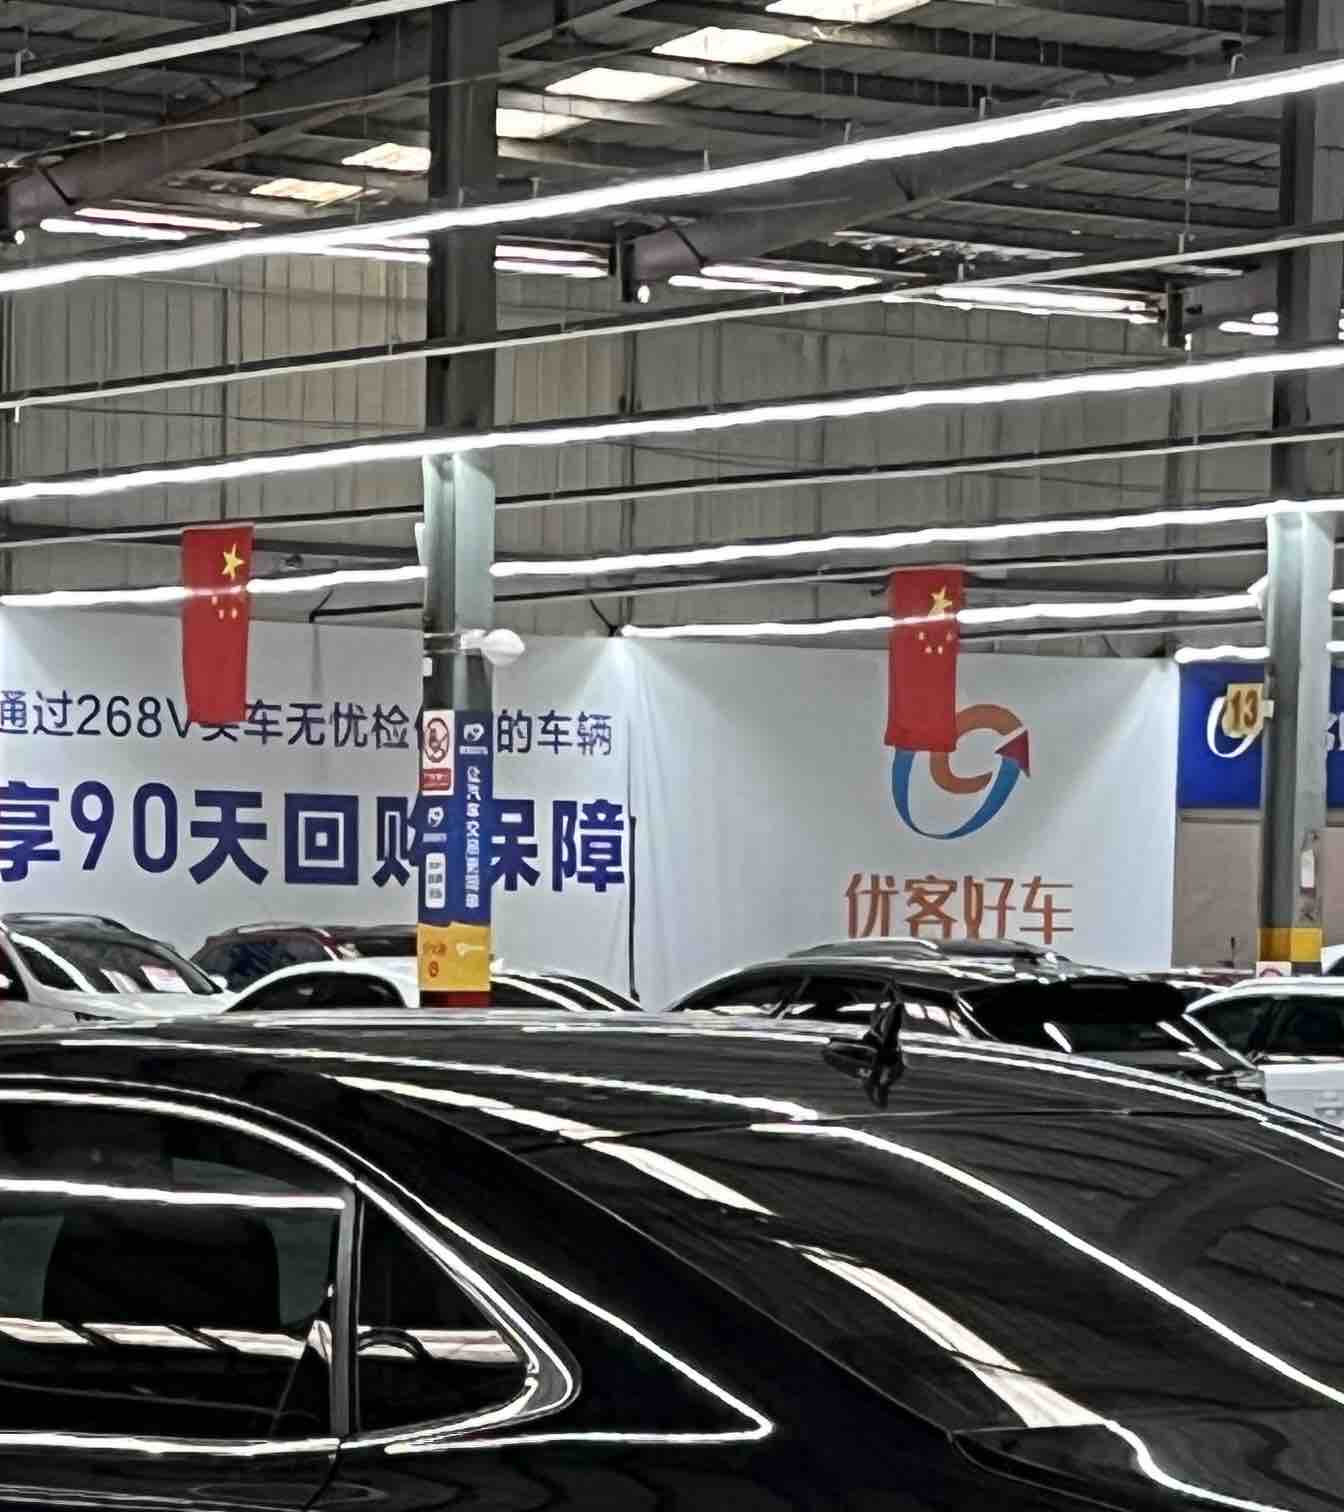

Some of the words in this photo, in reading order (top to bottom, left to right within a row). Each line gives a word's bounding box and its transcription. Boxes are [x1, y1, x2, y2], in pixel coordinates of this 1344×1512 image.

[1231, 689, 1258, 729] 13
[845, 872, 1074, 945] 优客好车
